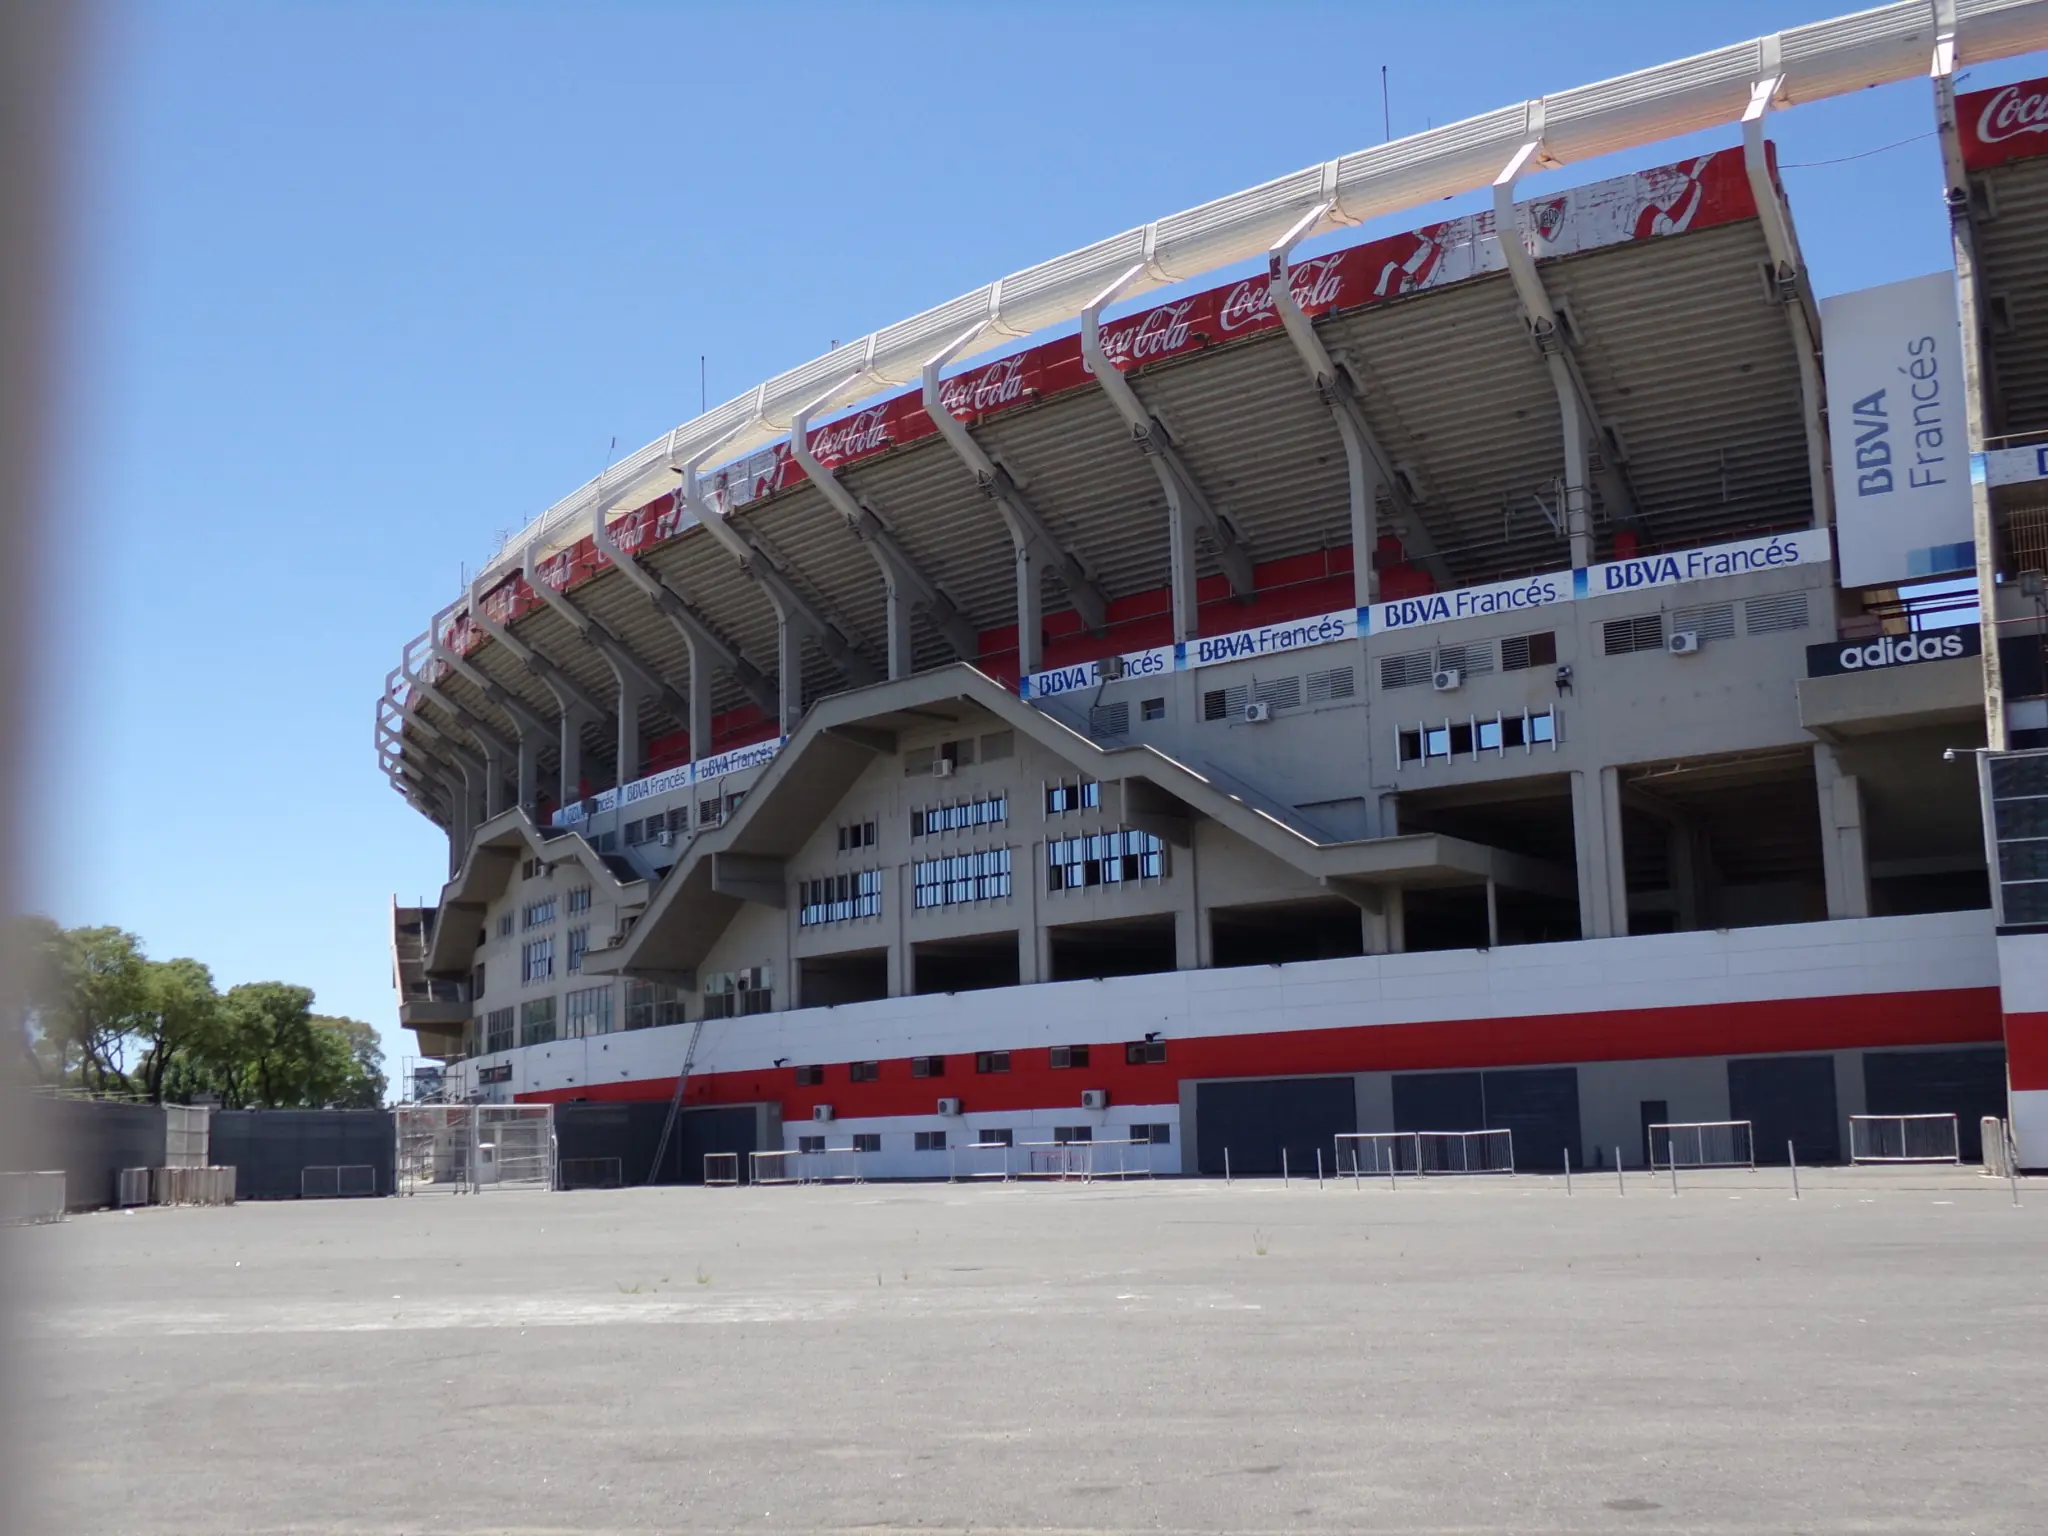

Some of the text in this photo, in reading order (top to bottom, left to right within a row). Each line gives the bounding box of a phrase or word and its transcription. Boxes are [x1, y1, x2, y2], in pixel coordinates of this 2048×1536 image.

[1897, 335, 1947, 489] Francés
[1853, 388, 1894, 498] BBVA
[1605, 538, 1799, 591] BBVA Francés
[1384, 578, 1556, 628] BBVA Francés
[1199, 616, 1345, 663] BBVA Francés
[1840, 633, 1964, 670] adidas
[1039, 650, 1164, 696] BBVA Fncés
[701, 756, 729, 779] BBVA
